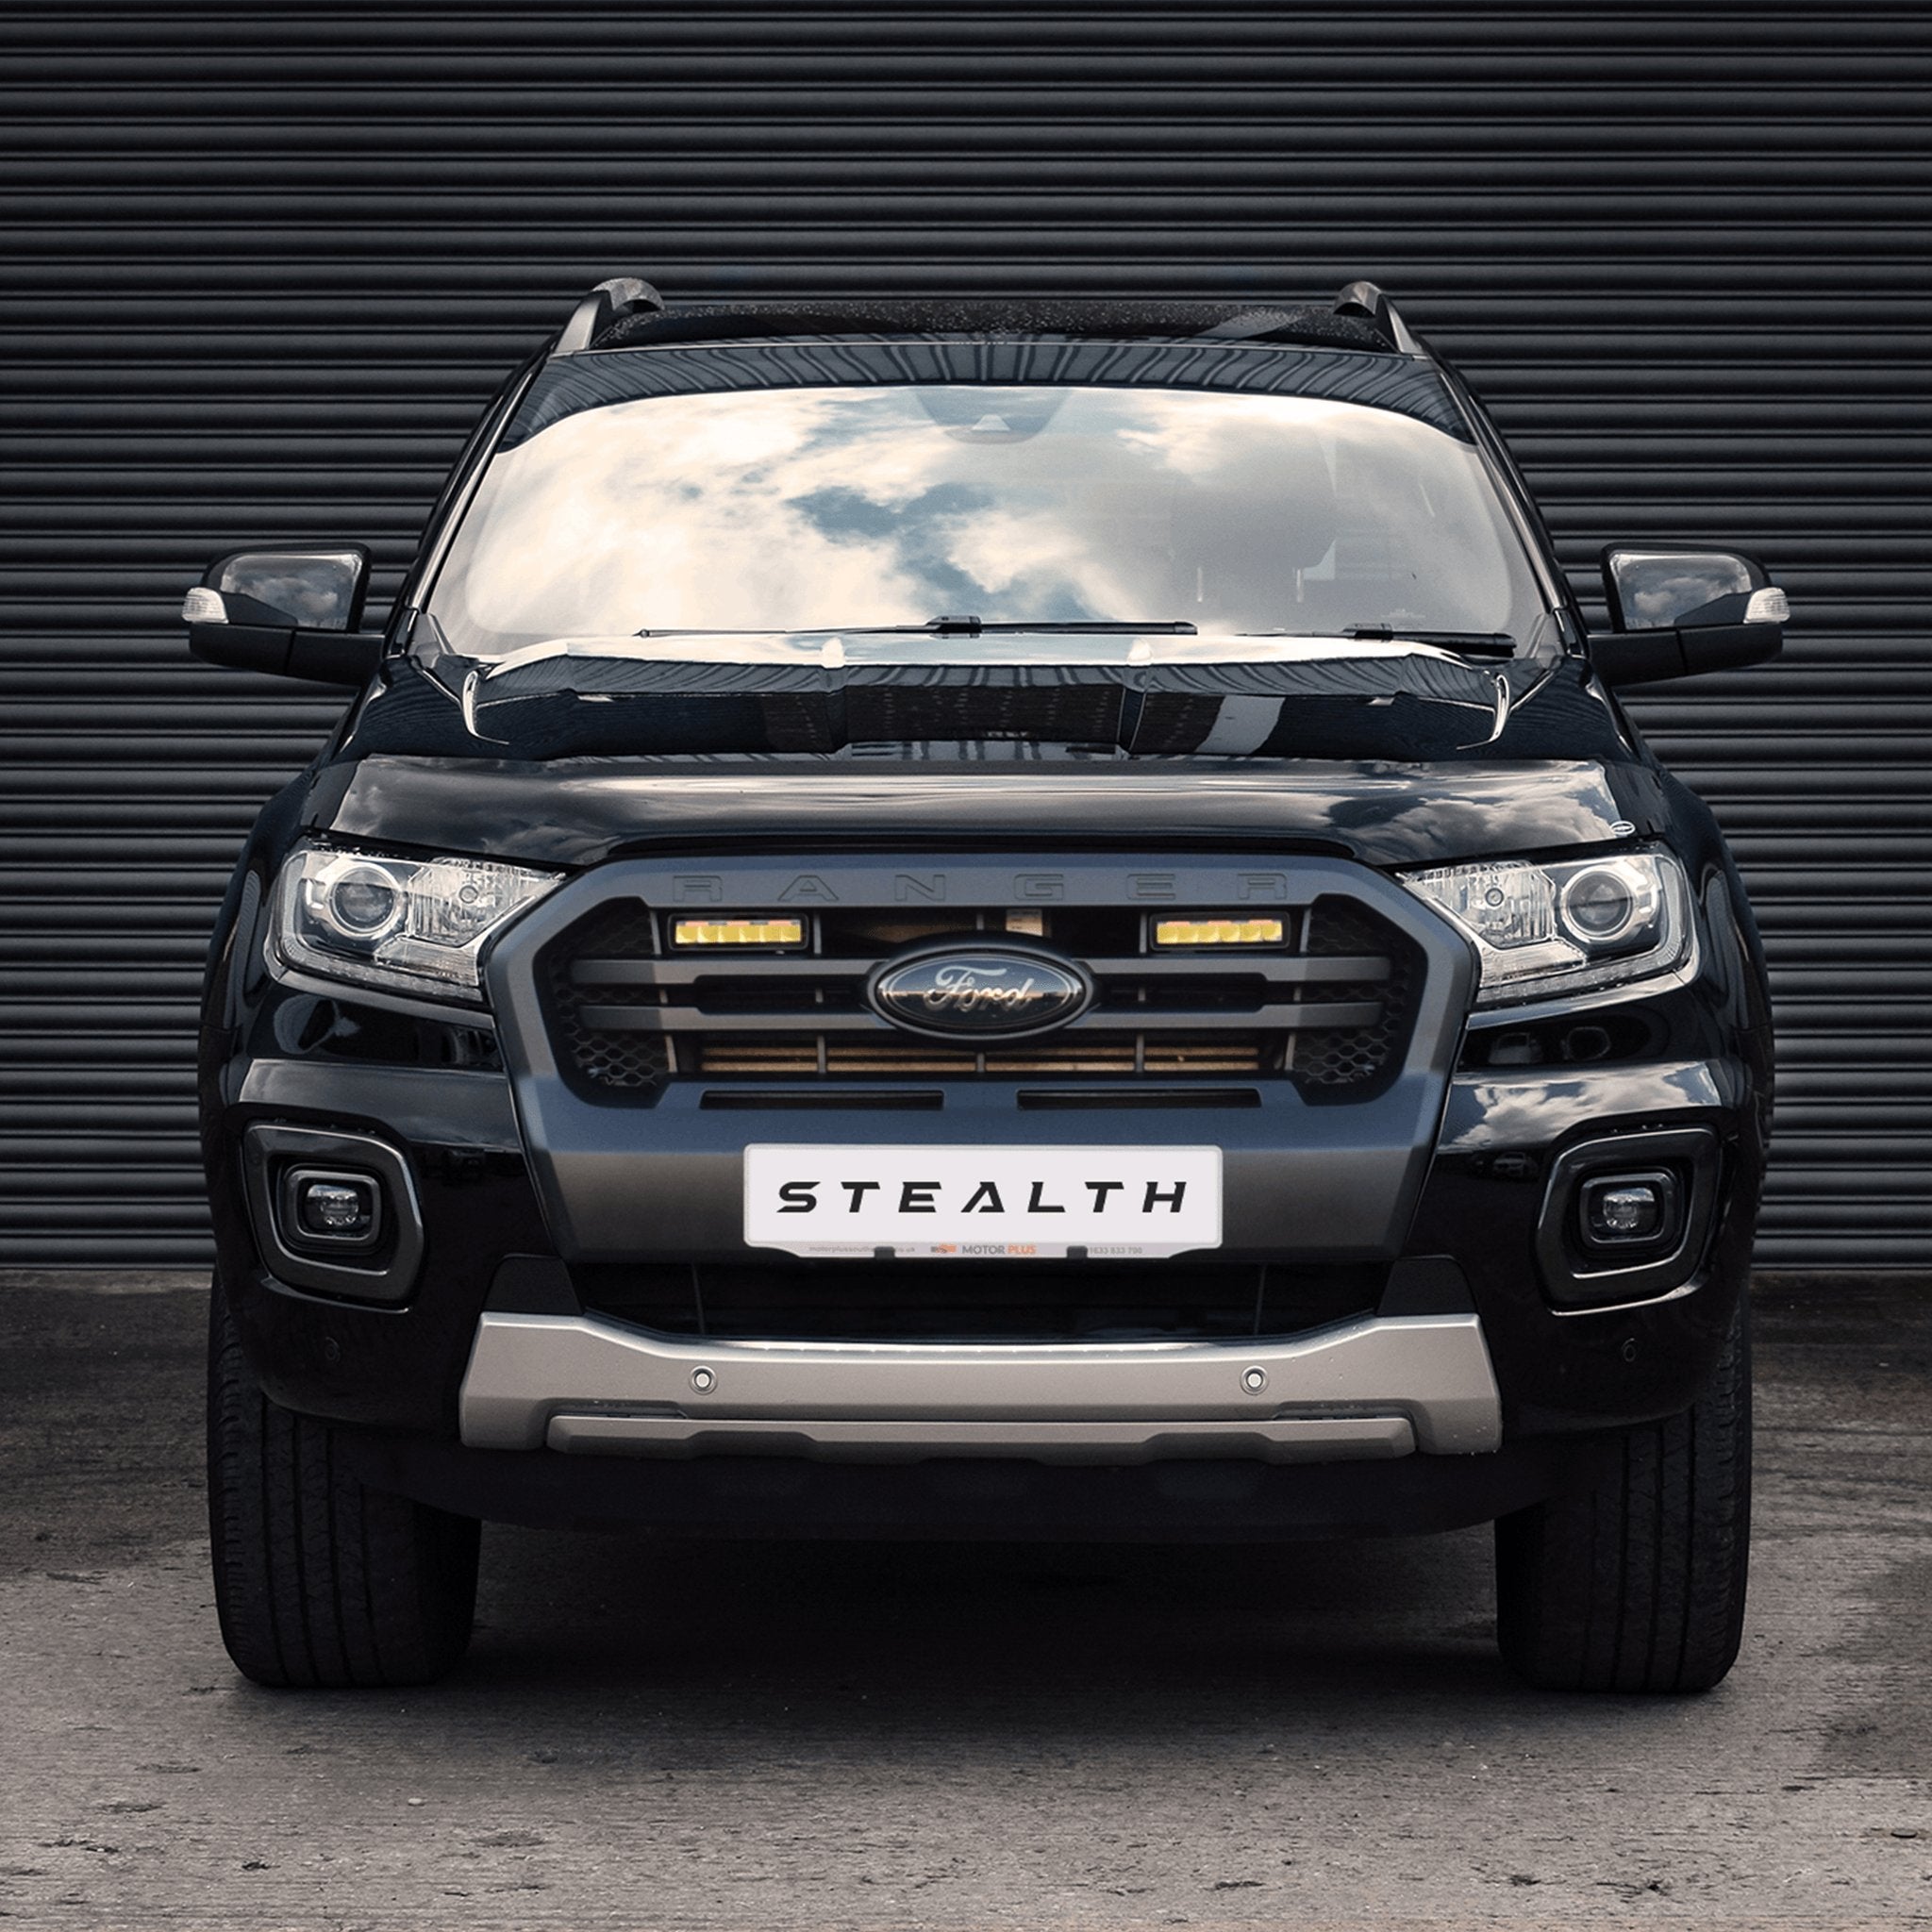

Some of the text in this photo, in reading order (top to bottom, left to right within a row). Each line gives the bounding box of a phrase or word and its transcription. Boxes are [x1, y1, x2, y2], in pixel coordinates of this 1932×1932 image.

[672, 873, 1289, 902] RANGER
[924, 965, 1035, 1009] Ford
[776, 1181, 1187, 1213] STEALTH
[962, 1244, 1036, 1255] MOTOR PLUS
